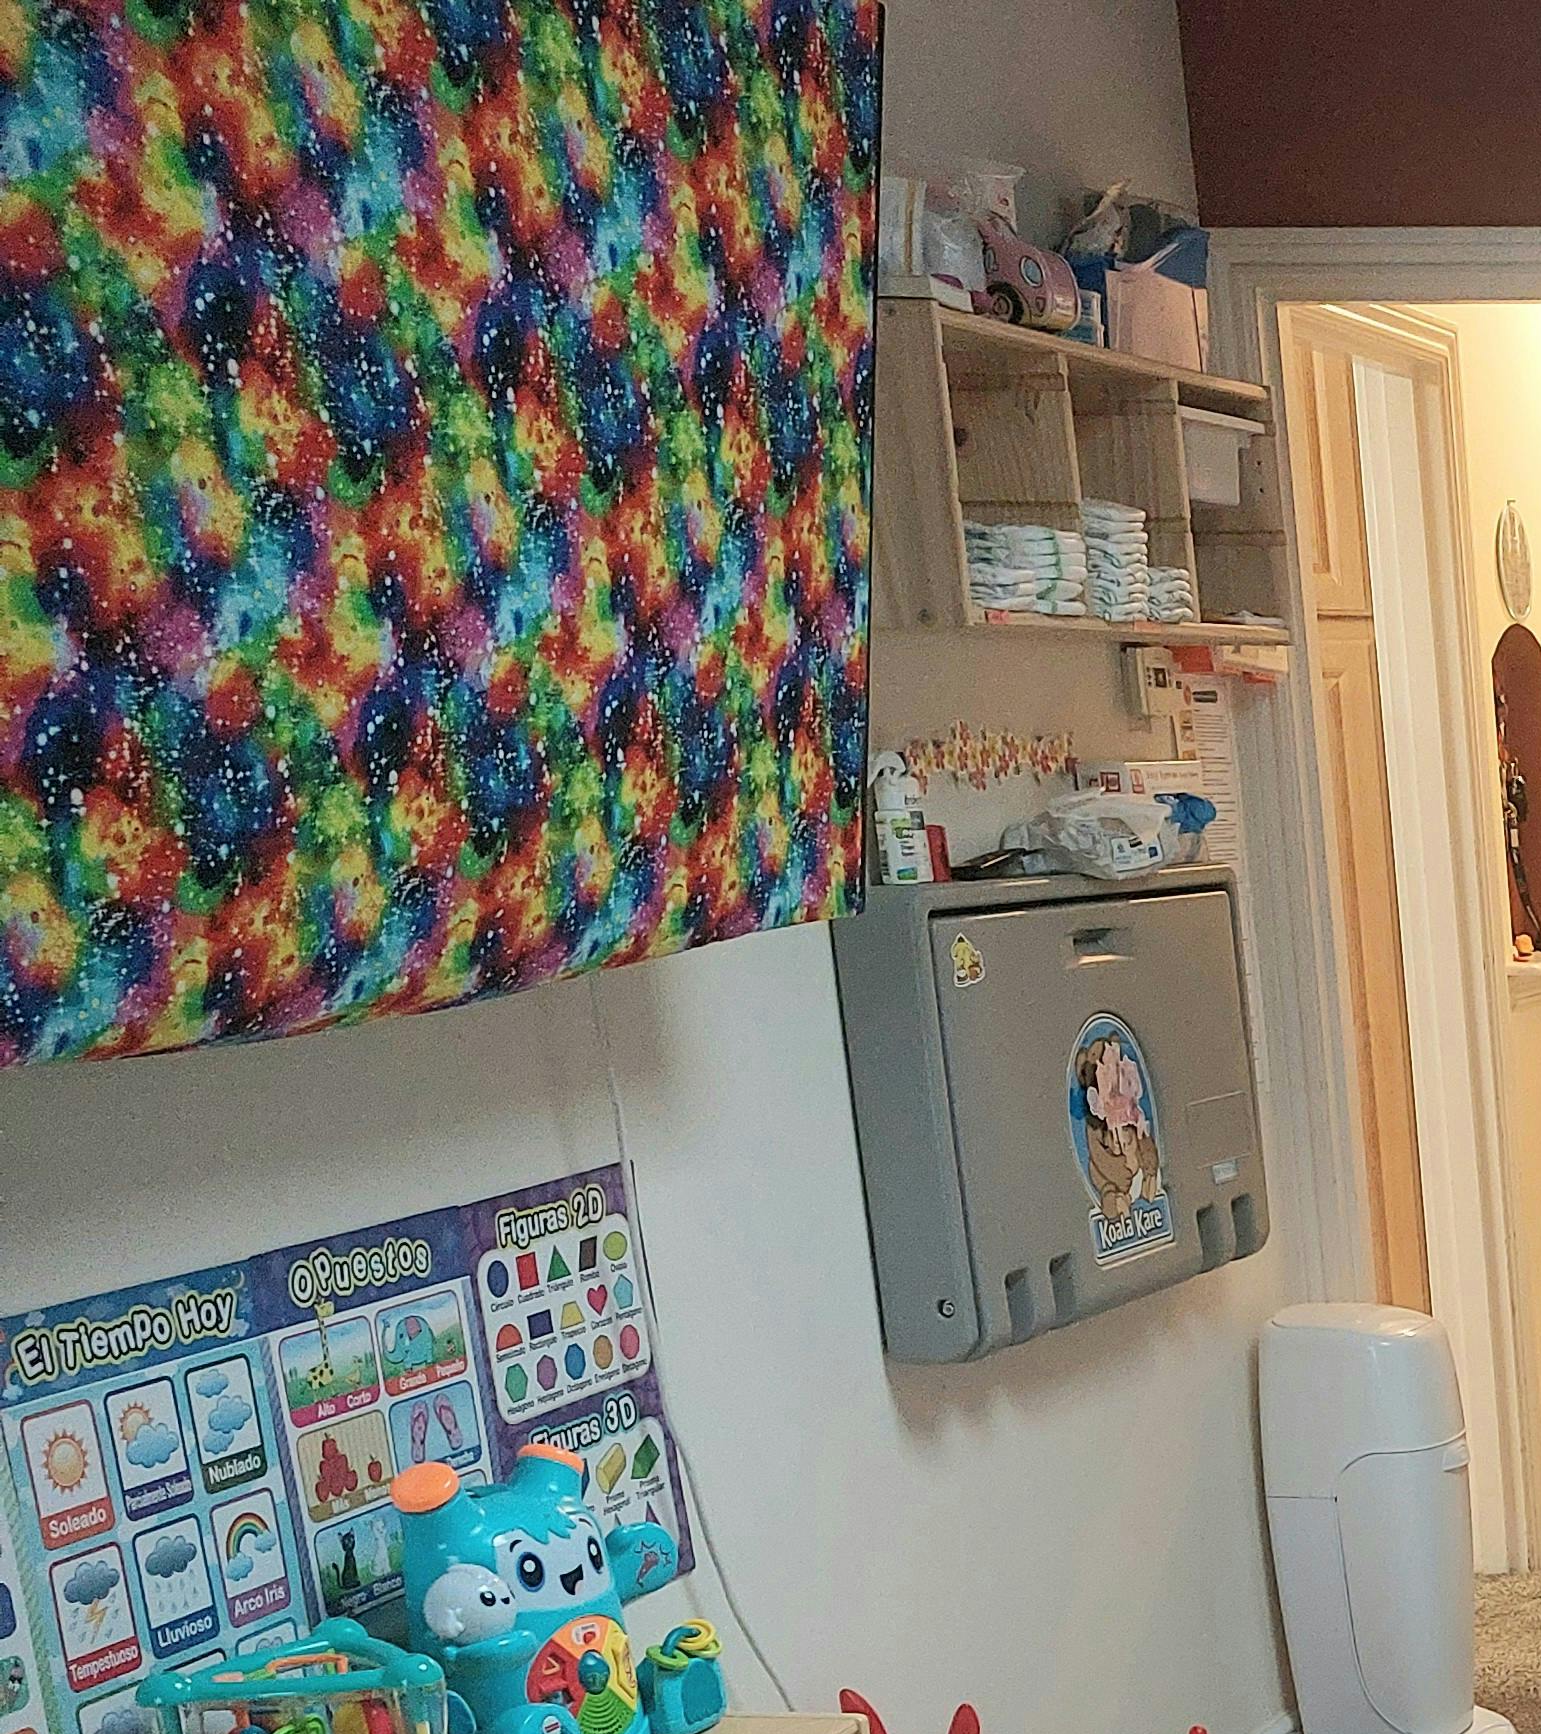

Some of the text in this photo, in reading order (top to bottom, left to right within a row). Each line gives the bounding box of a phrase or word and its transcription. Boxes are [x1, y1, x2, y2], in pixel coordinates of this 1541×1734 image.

[498, 1187, 604, 1249] Figuras 2D
[1098, 1208, 1163, 1250] Koala Kare
[15, 1333, 56, 1381] El
[175, 1291, 234, 1339] Hoy
[605, 1393, 637, 1434] 3D
[207, 1453, 262, 1485] Nublado
[49, 1505, 107, 1538] Soleado
[233, 1584, 287, 1619] Arco Iris
[157, 1614, 214, 1648] Lluvioso
[69, 1644, 139, 1683] Tempestuoso
